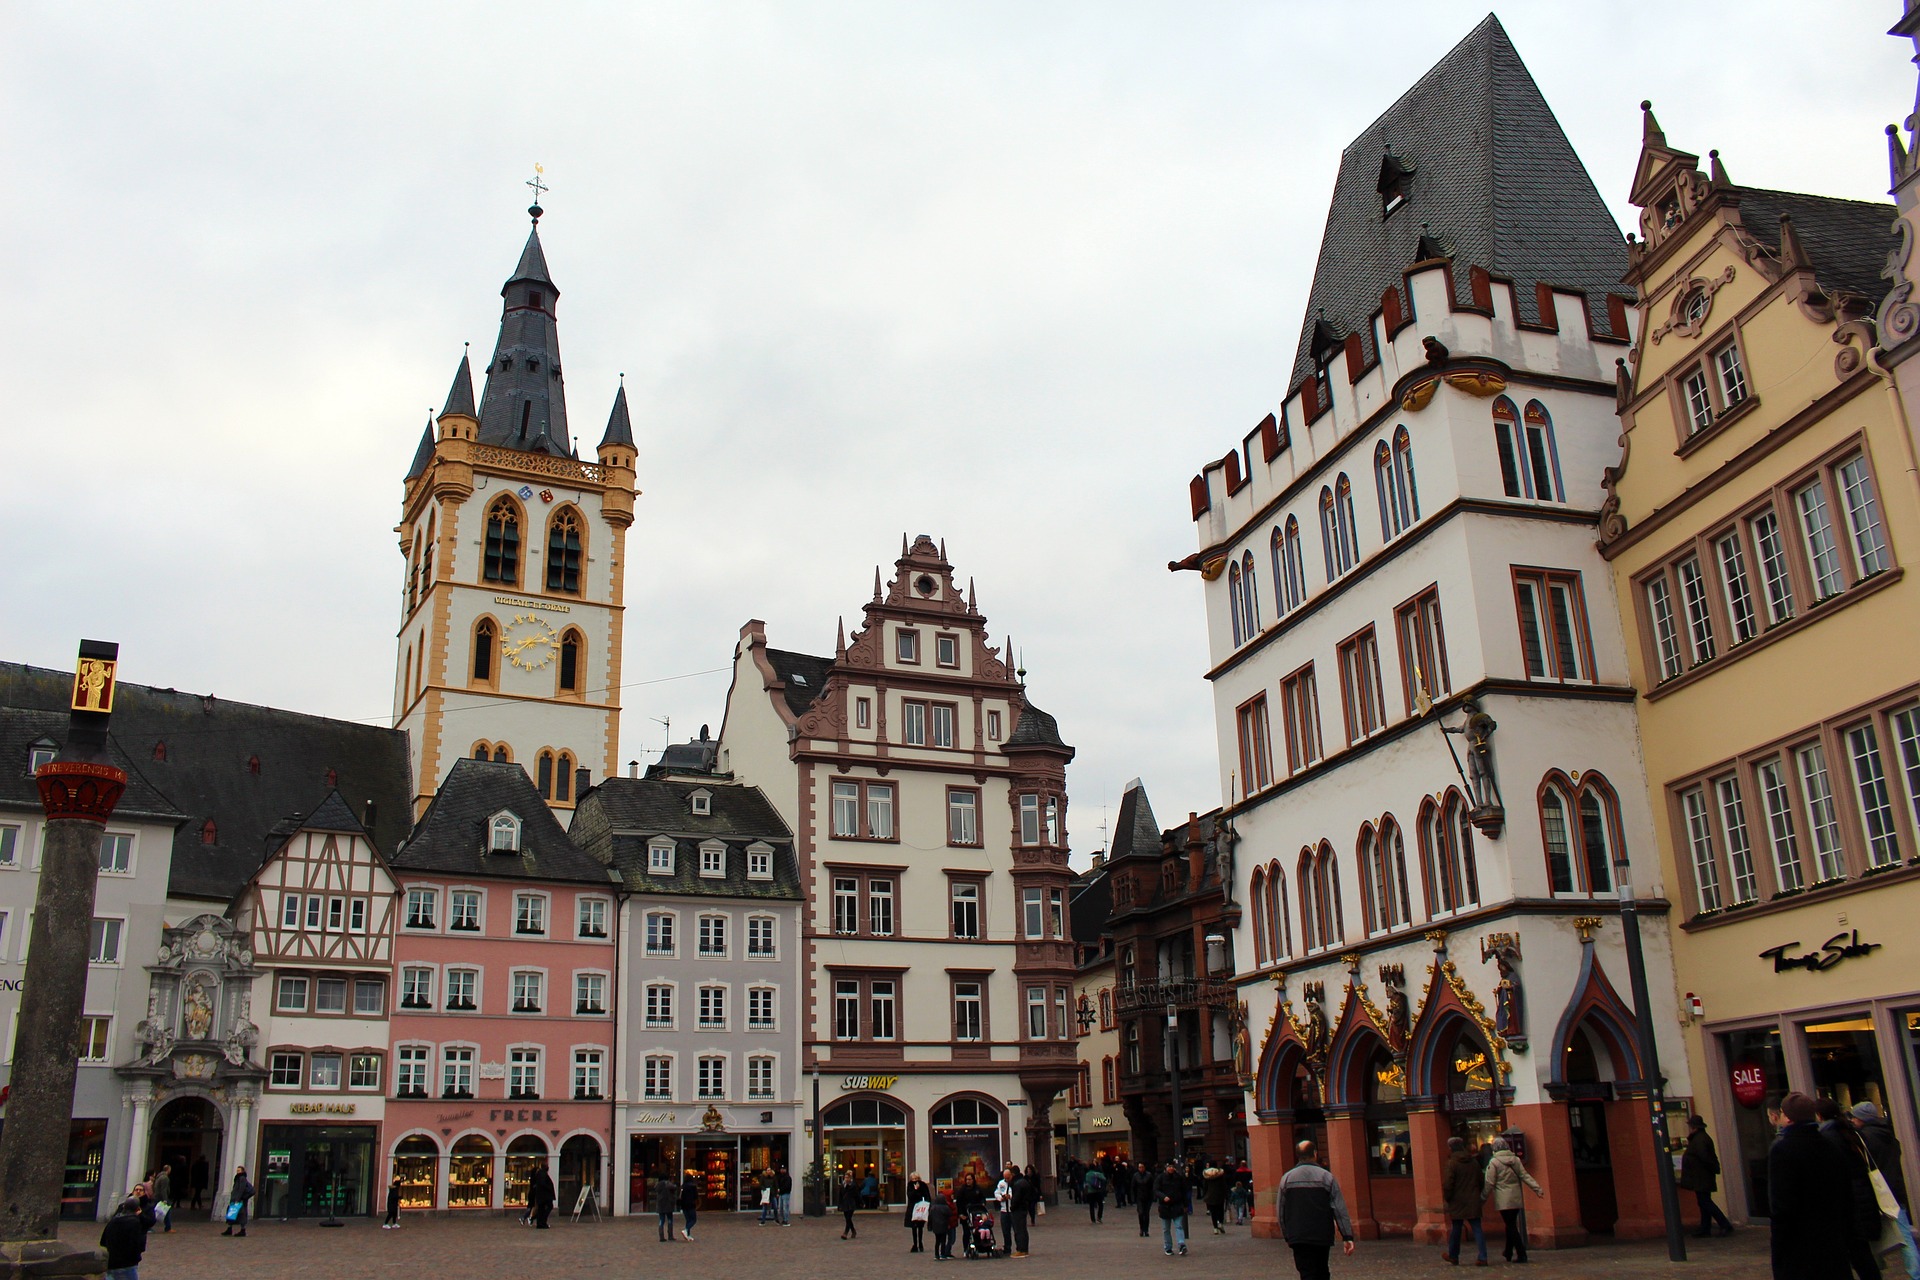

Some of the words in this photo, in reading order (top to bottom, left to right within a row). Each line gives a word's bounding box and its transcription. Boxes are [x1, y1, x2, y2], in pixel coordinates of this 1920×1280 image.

[46, 764, 109, 776] TREVERENSIS
[841, 1075, 899, 1090] SUBWAY
[1733, 1068, 1762, 1086] SALE
[325, 1103, 355, 1114] HAUS
[637, 1111, 668, 1124] Lindt
[1092, 1117, 1113, 1127] MANGO
